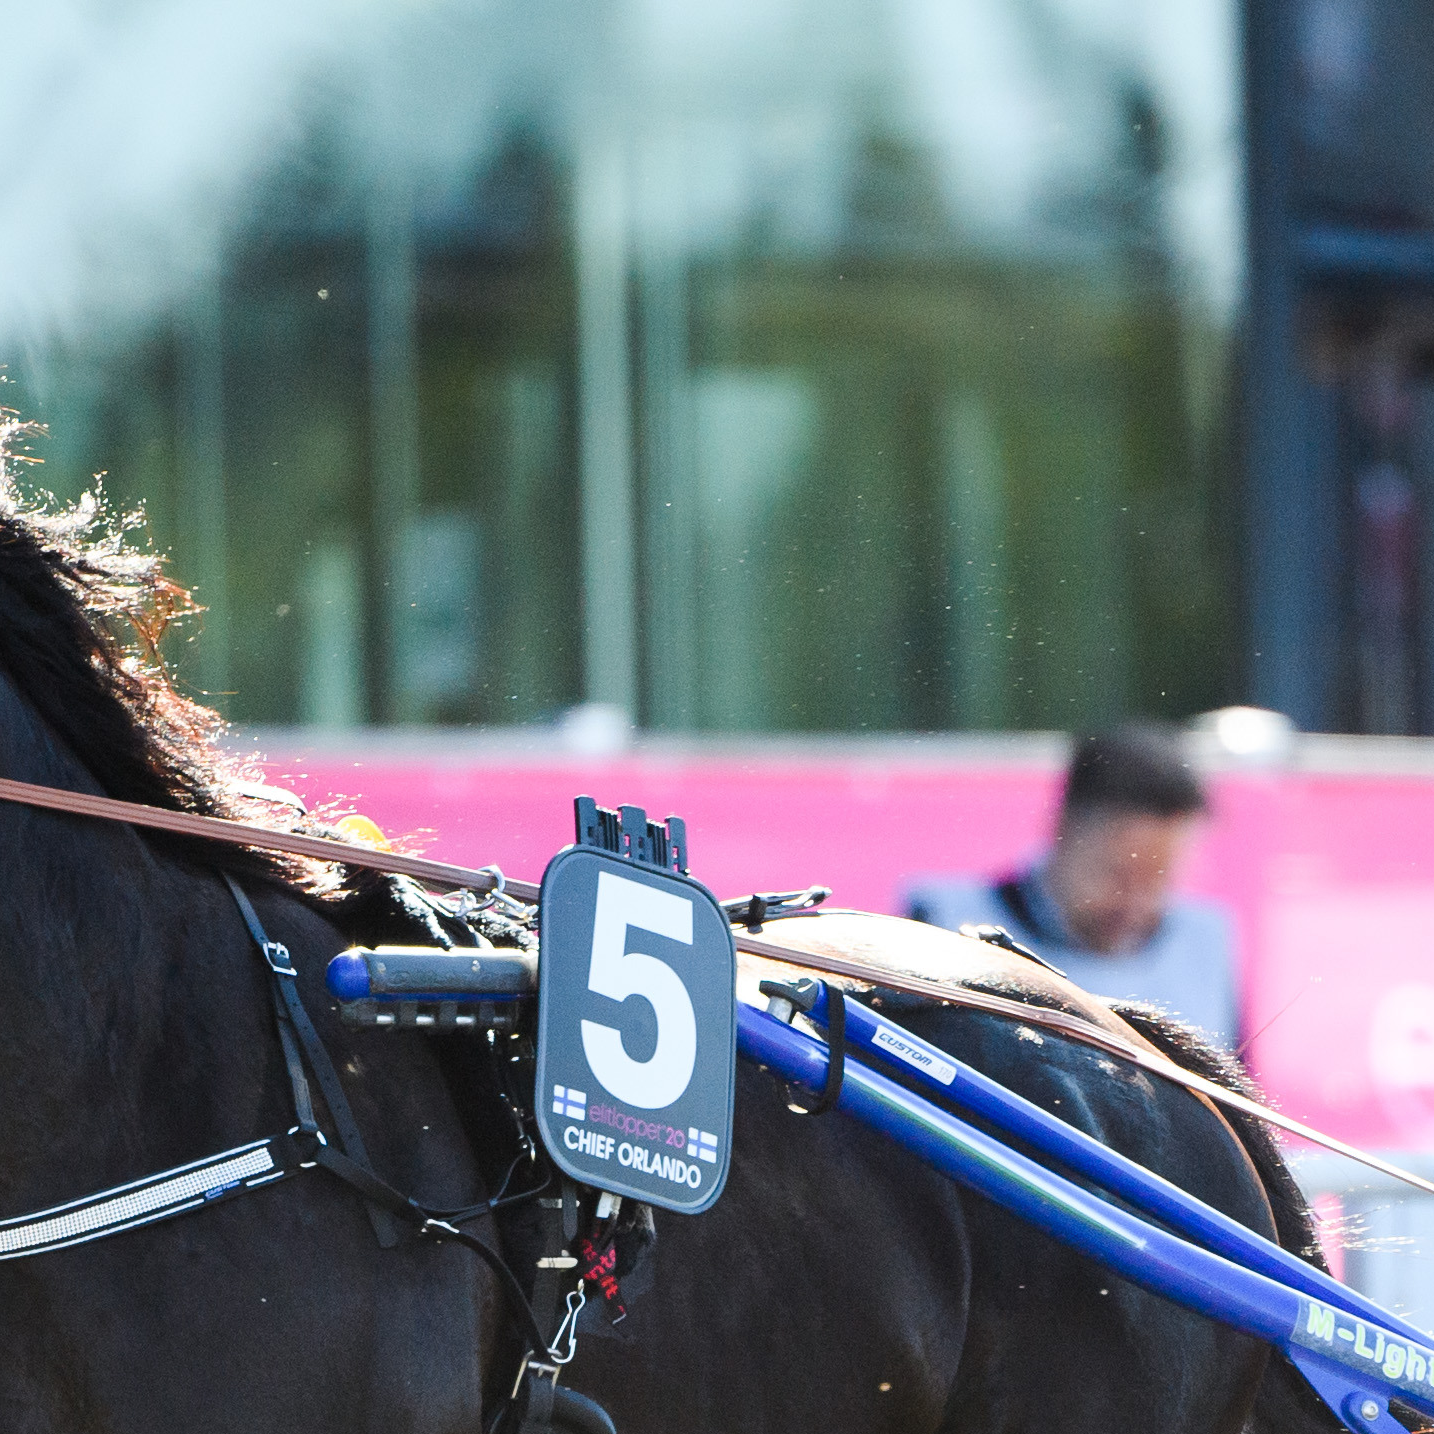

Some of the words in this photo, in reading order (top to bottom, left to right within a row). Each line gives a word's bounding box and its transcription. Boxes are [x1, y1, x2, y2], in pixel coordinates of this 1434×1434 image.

[581, 871, 697, 1110] 5
[879, 1033, 933, 1066] CUSTOM
[564, 1125, 616, 1161] CHIEF
[617, 1142, 702, 1189] ORLANDO
